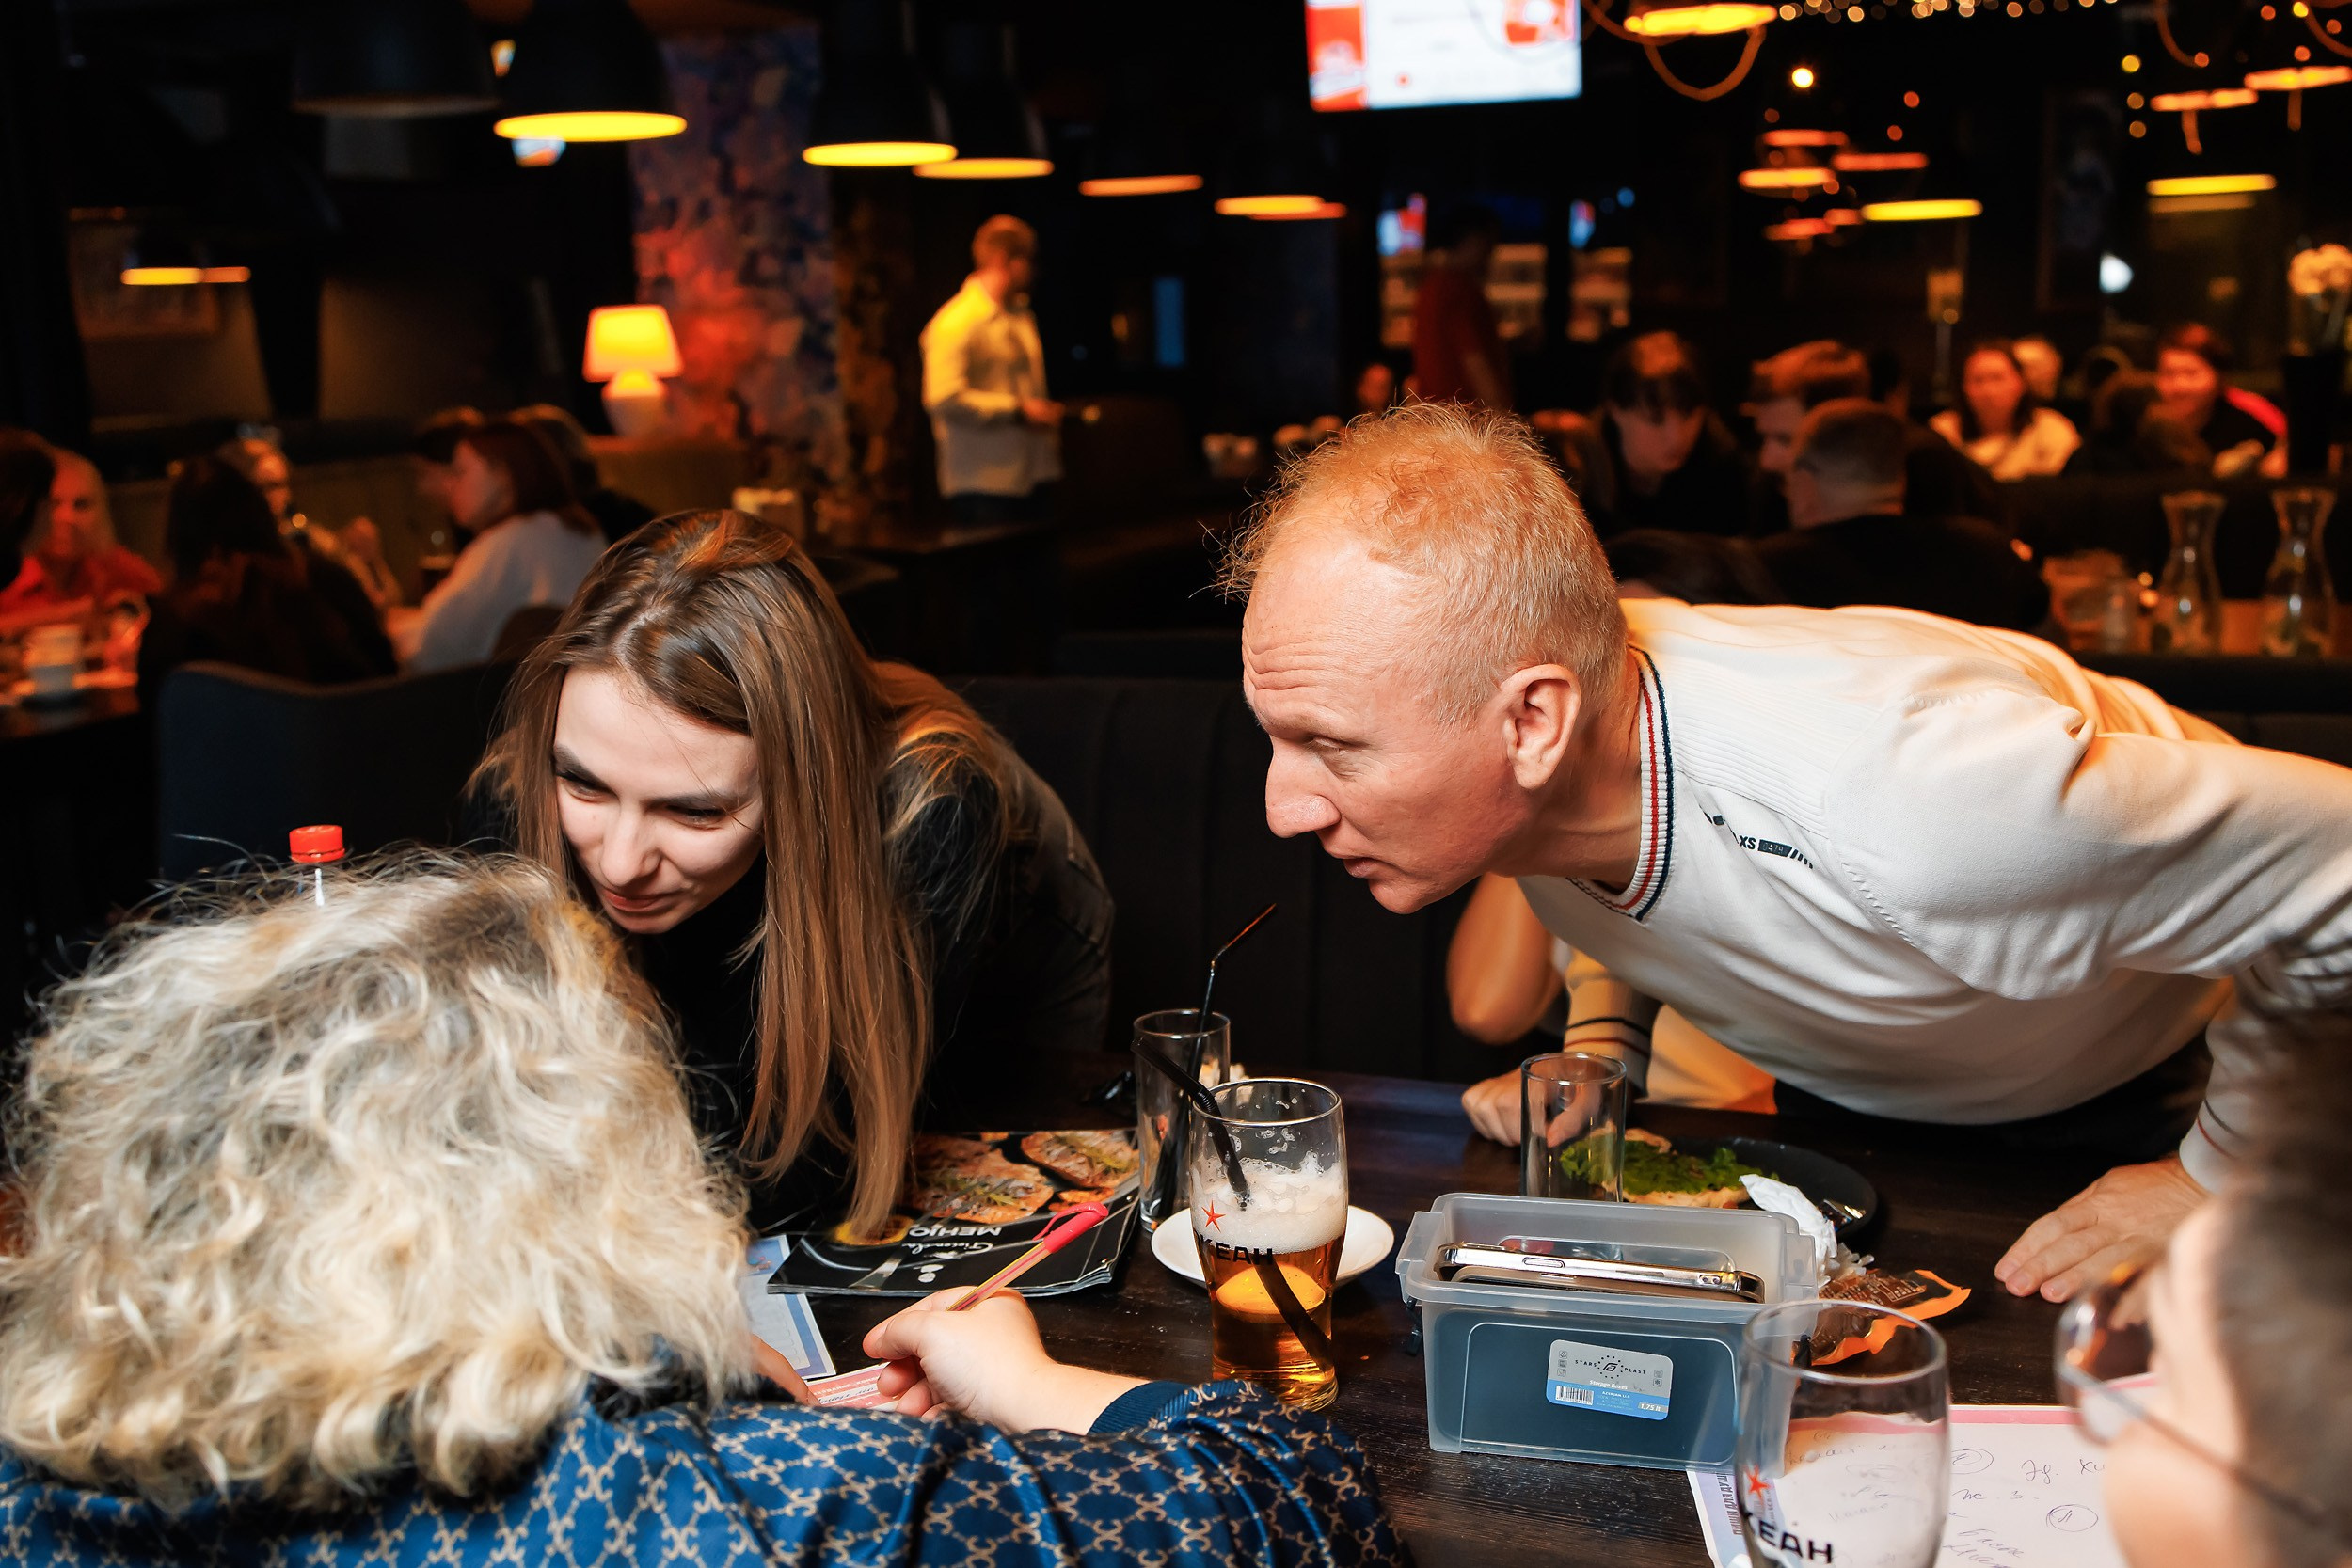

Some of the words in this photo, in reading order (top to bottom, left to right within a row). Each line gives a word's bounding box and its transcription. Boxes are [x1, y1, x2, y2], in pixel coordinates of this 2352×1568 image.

[908, 1226, 1002, 1238] МЕНЮ
[1575, 1359, 1597, 1368] STARS
[1624, 1367, 1646, 1375] PLAST
[1640, 1402, 1655, 1411] 1.75
[1721, 1493, 1738, 1511] ДЛЯ
